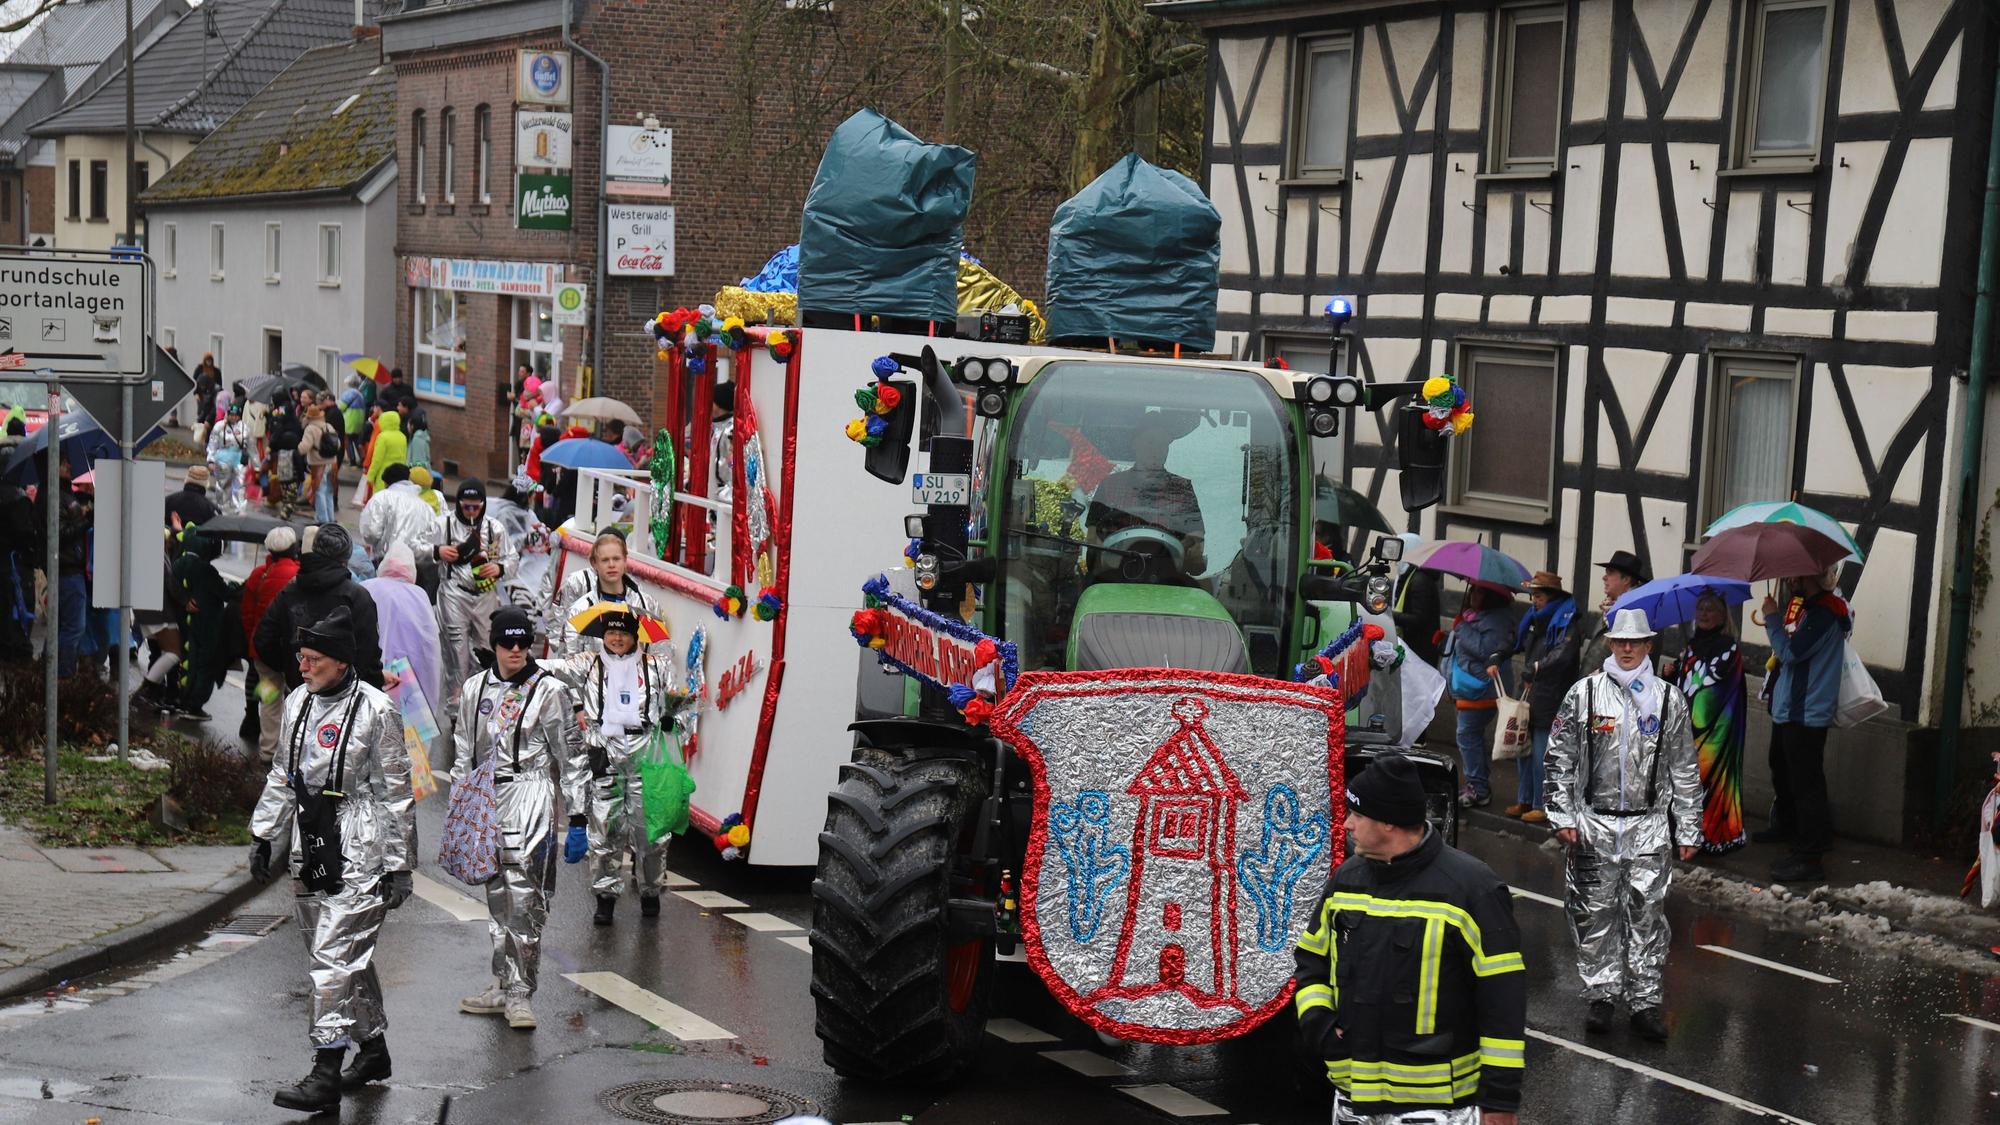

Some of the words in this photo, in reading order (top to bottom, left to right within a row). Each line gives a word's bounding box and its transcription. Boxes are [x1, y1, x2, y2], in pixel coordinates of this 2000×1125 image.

[556, 118, 571, 133] Grill
[521, 189, 569, 218] Mythos
[611, 209, 672, 220] Westerwald-
[631, 223, 651, 235] Grill
[617, 238, 626, 249] P
[1, 266, 120, 287] rundschule
[517, 263, 543, 281] GRILL
[476, 280, 495, 290] PIZZA
[0, 291, 124, 314] portanlagen
[926, 476, 943, 488] SU
[922, 491, 930, 502] V
[934, 491, 960, 503] 219
[505, 628, 526, 636] NASA
